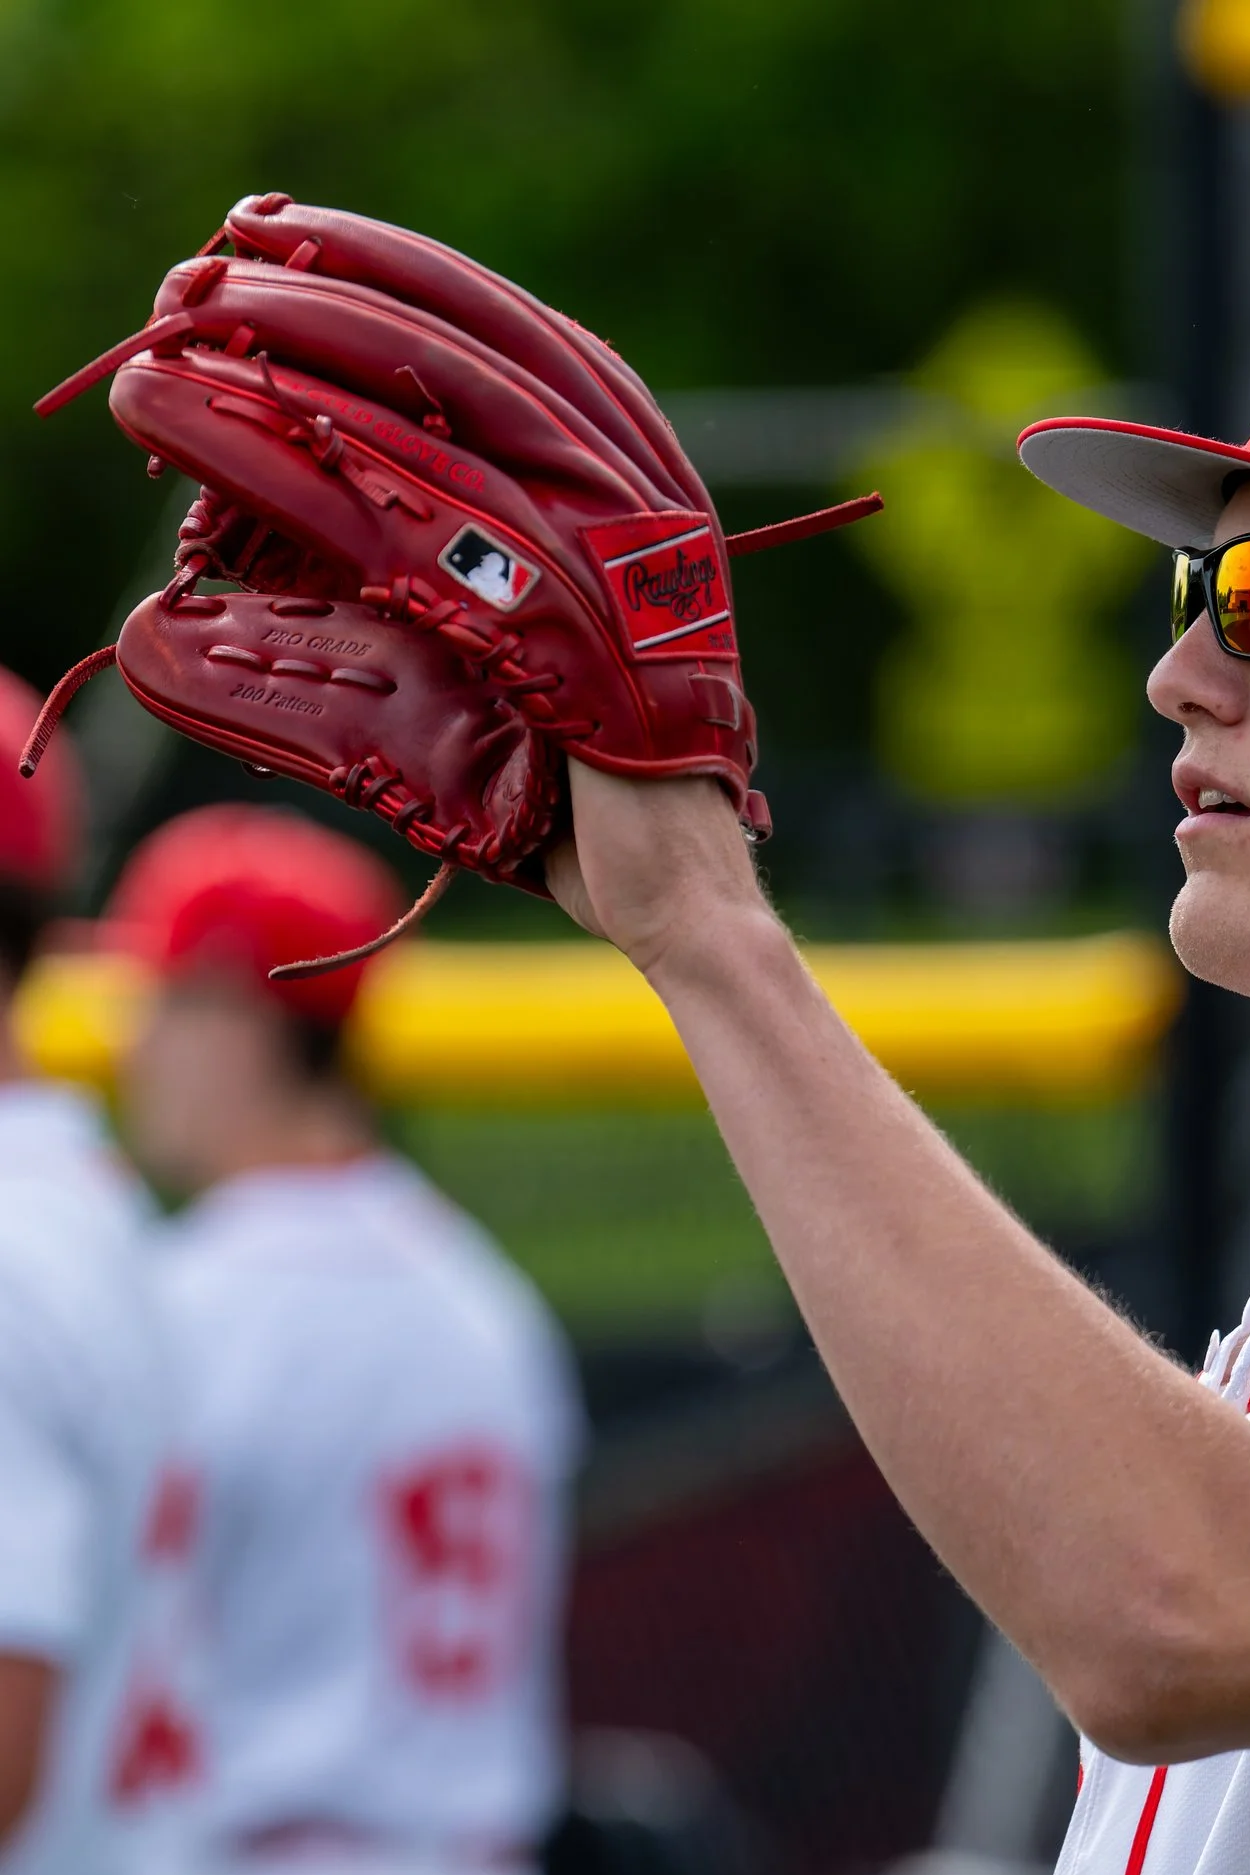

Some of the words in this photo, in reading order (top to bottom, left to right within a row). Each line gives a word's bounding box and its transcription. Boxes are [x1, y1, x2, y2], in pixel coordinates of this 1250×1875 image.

[373, 421, 451, 475] GLOVE
[261, 629, 303, 645] PRO
[307, 635, 372, 656] GRADE
[229, 683, 265, 701] 200
[265, 691, 325, 716] Pattern
